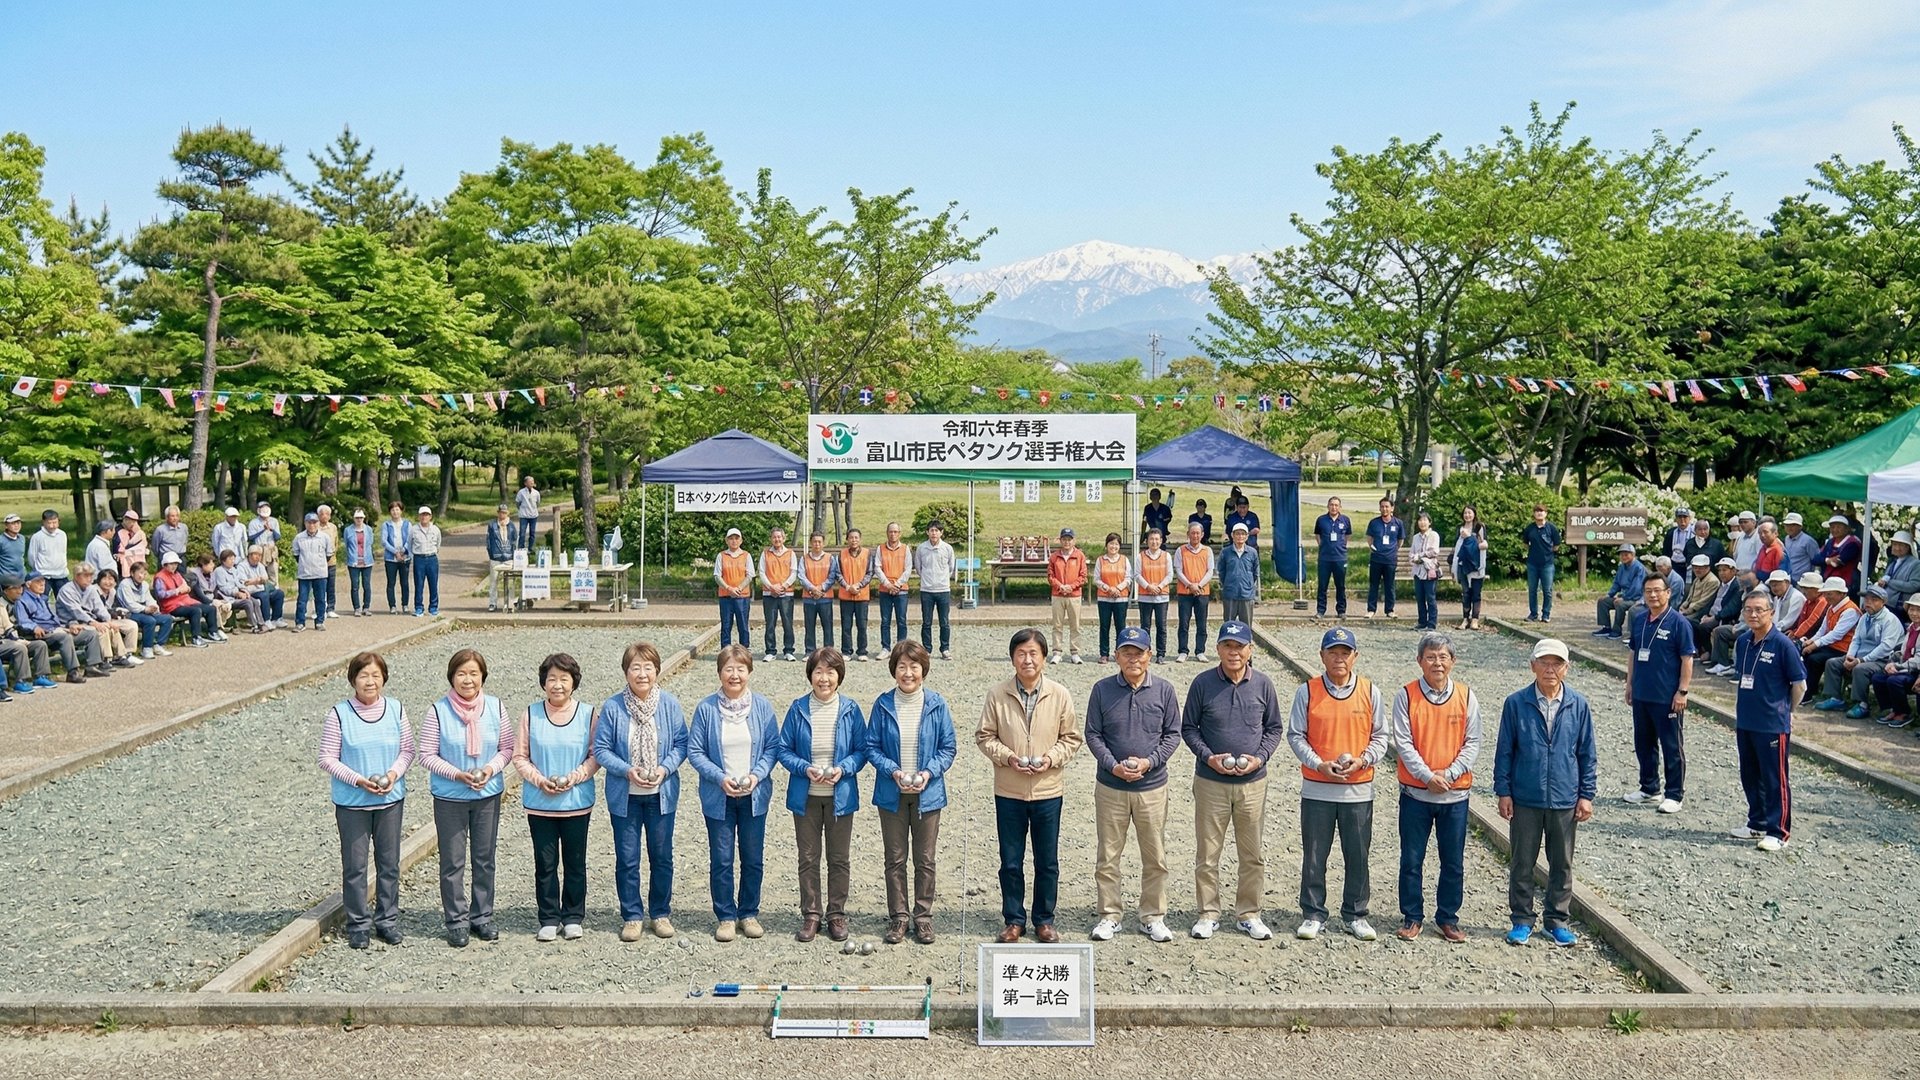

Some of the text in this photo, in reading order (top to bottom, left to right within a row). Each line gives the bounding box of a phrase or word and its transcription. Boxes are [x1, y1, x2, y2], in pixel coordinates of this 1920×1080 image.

[942, 419, 1049, 438] 令和六年春季
[866, 440, 1127, 463] 富山市民ペタンク選手権大会
[1002, 964, 1070, 982] 準々決勝
[1002, 988, 1070, 1006] 第一試合
